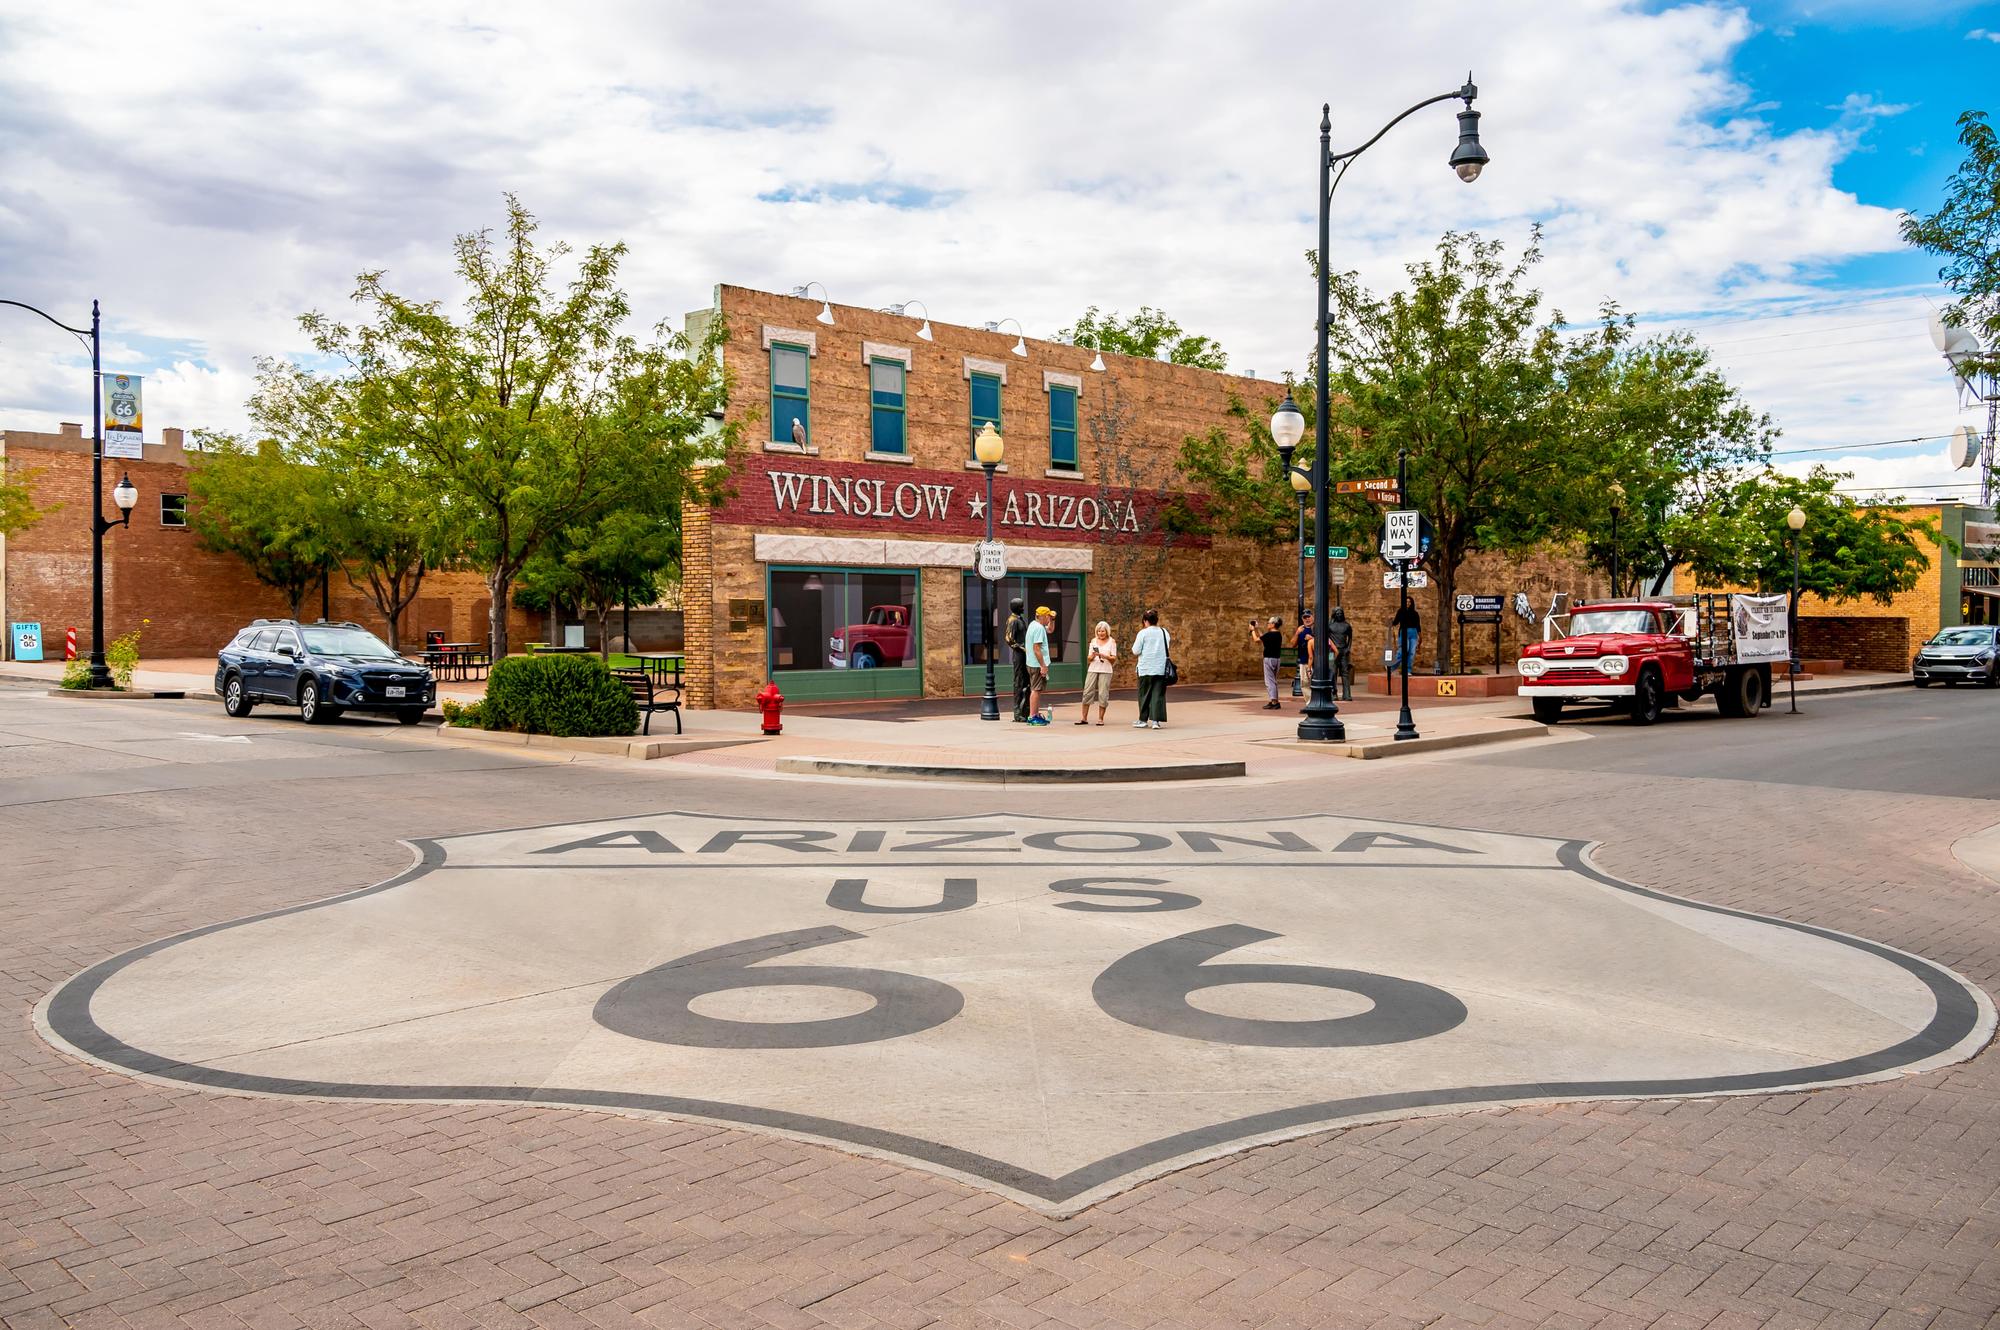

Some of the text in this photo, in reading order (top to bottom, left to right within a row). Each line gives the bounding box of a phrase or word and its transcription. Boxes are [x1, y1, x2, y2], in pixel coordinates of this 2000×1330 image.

[116, 404, 132, 415] 66
[1364, 480, 1388, 490] Second
[766, 470, 1140, 533] WINSLOW ARIZONA
[1390, 515, 1414, 527] ONE
[1390, 528, 1414, 540] WAY
[1460, 600, 1472, 609] 66
[526, 829, 1488, 855] ARIZONA
